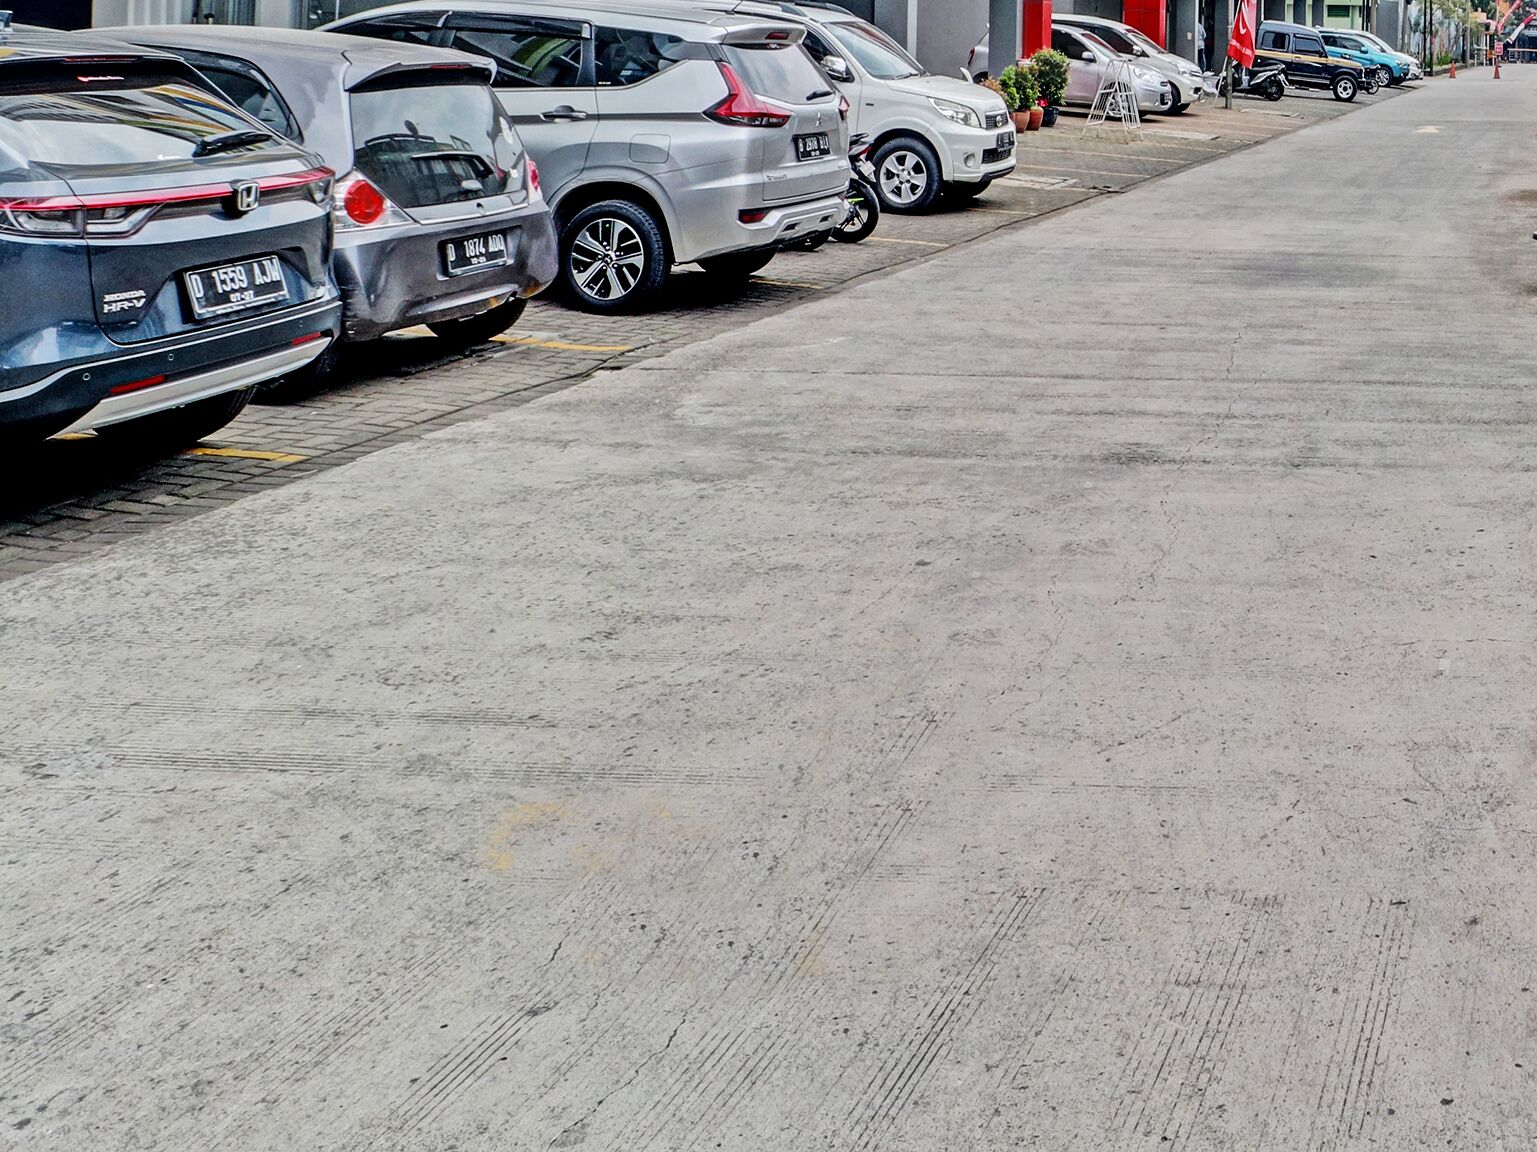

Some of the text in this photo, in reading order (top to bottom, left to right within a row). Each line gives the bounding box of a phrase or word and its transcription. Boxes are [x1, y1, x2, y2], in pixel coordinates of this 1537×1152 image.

[447, 243, 456, 261] D
[190, 258, 282, 298] D 1559 AJW
[103, 298, 147, 314] HR-V
